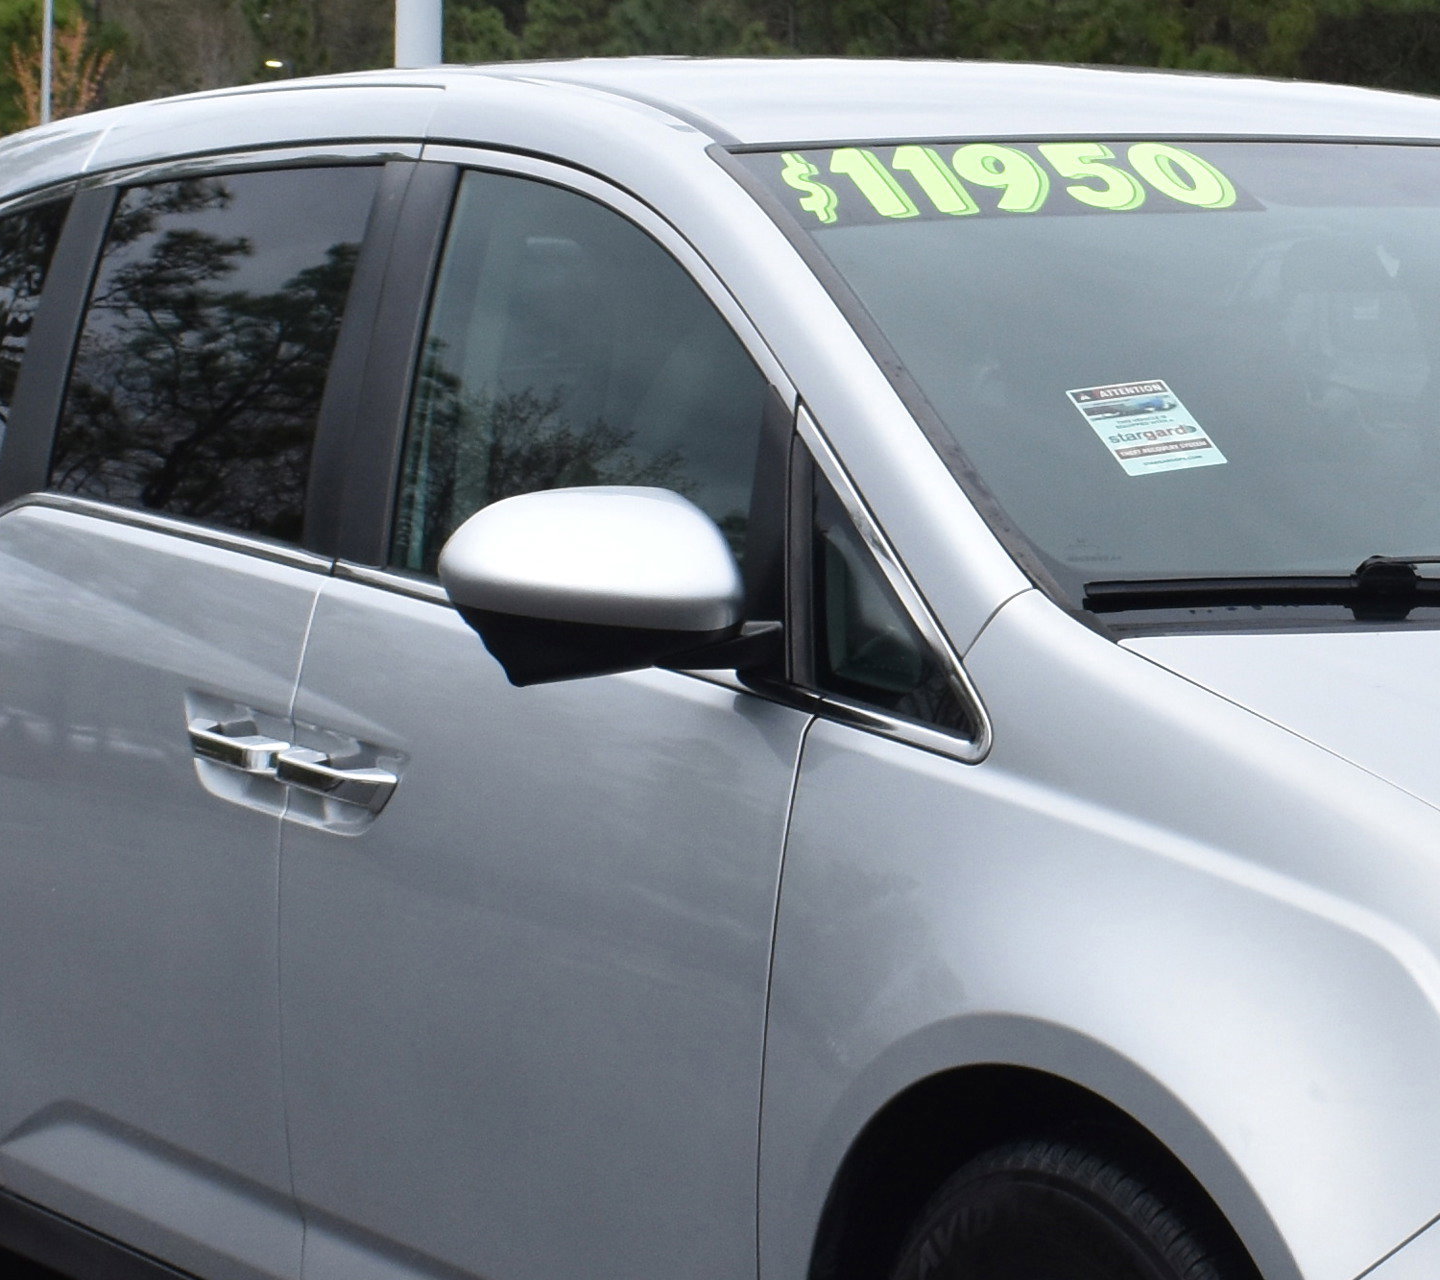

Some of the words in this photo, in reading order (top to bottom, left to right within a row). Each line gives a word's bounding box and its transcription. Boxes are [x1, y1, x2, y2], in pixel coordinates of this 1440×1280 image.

[781, 143, 1237, 223] $11950
[1098, 382, 1163, 399] ATTENTION
[1108, 424, 1187, 444] stargard
